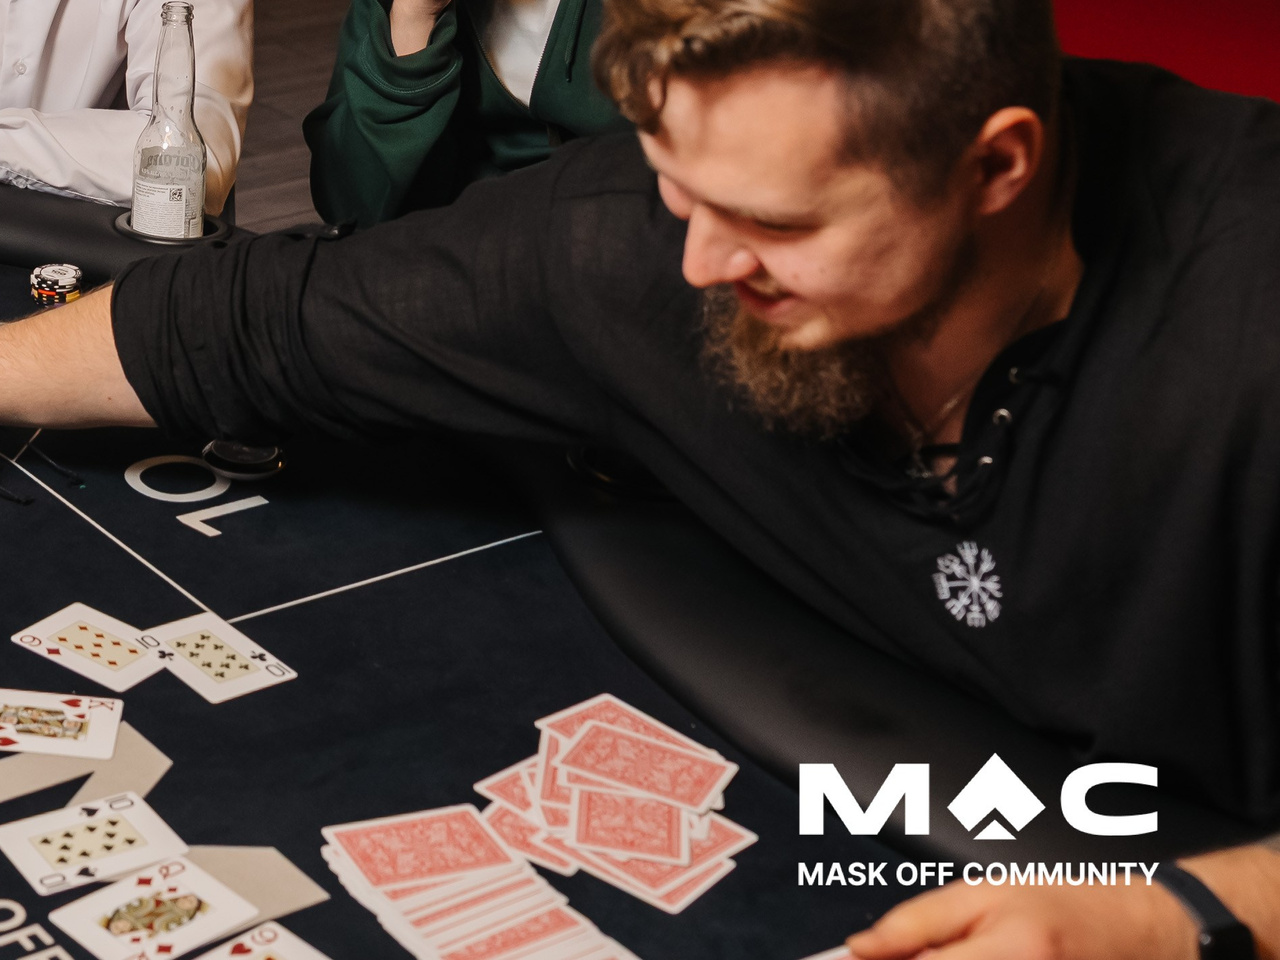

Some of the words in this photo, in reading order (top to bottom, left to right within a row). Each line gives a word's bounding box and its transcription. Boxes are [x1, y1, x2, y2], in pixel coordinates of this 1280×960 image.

[124, 455, 269, 537] 10
[19, 634, 42, 647] 9
[135, 634, 161, 650] 10
[265, 662, 291, 678] 10
[88, 698, 115, 712] K
[158, 861, 186, 880] Q
